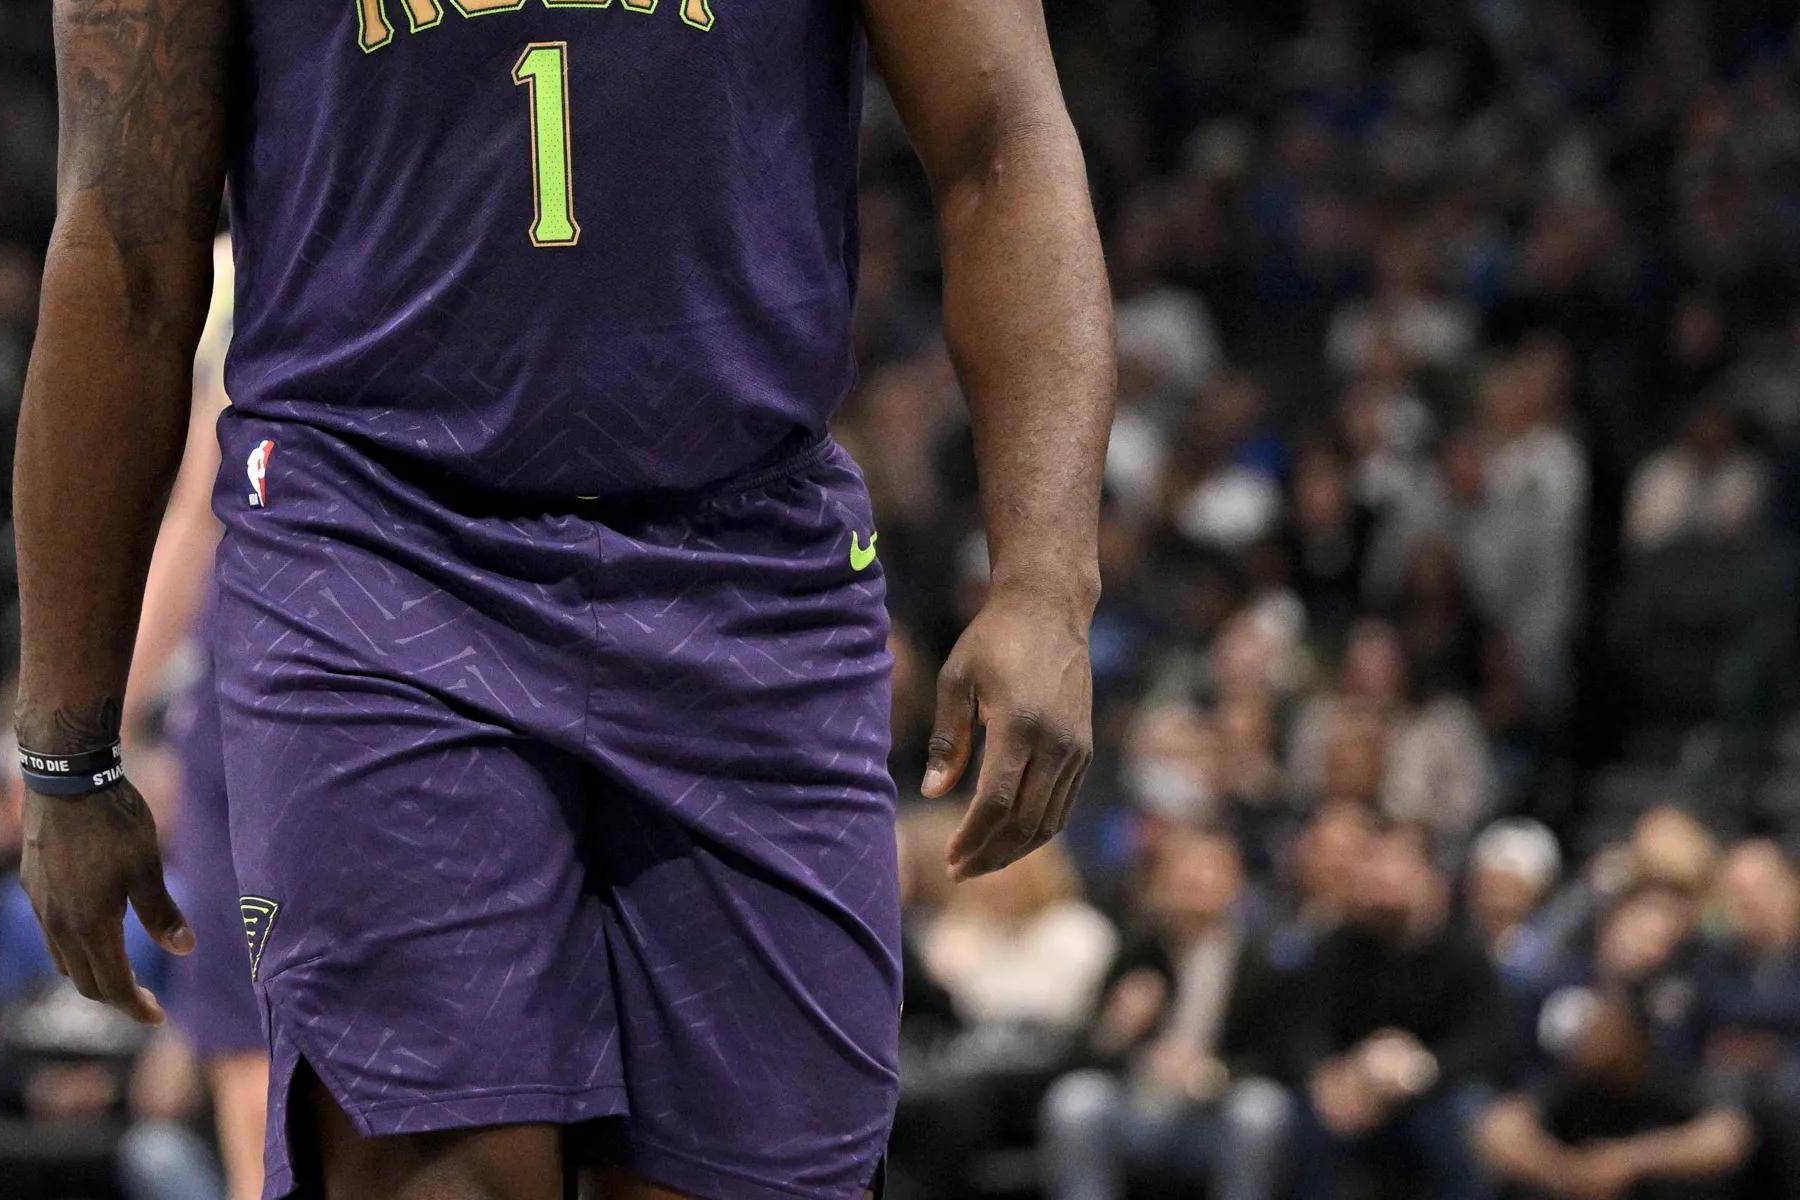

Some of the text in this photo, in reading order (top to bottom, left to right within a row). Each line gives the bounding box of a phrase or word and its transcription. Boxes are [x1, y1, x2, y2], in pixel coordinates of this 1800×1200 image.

[511, 41, 580, 247] 1
[29, 756, 44, 770] TO
[46, 760, 70, 772] DIE
